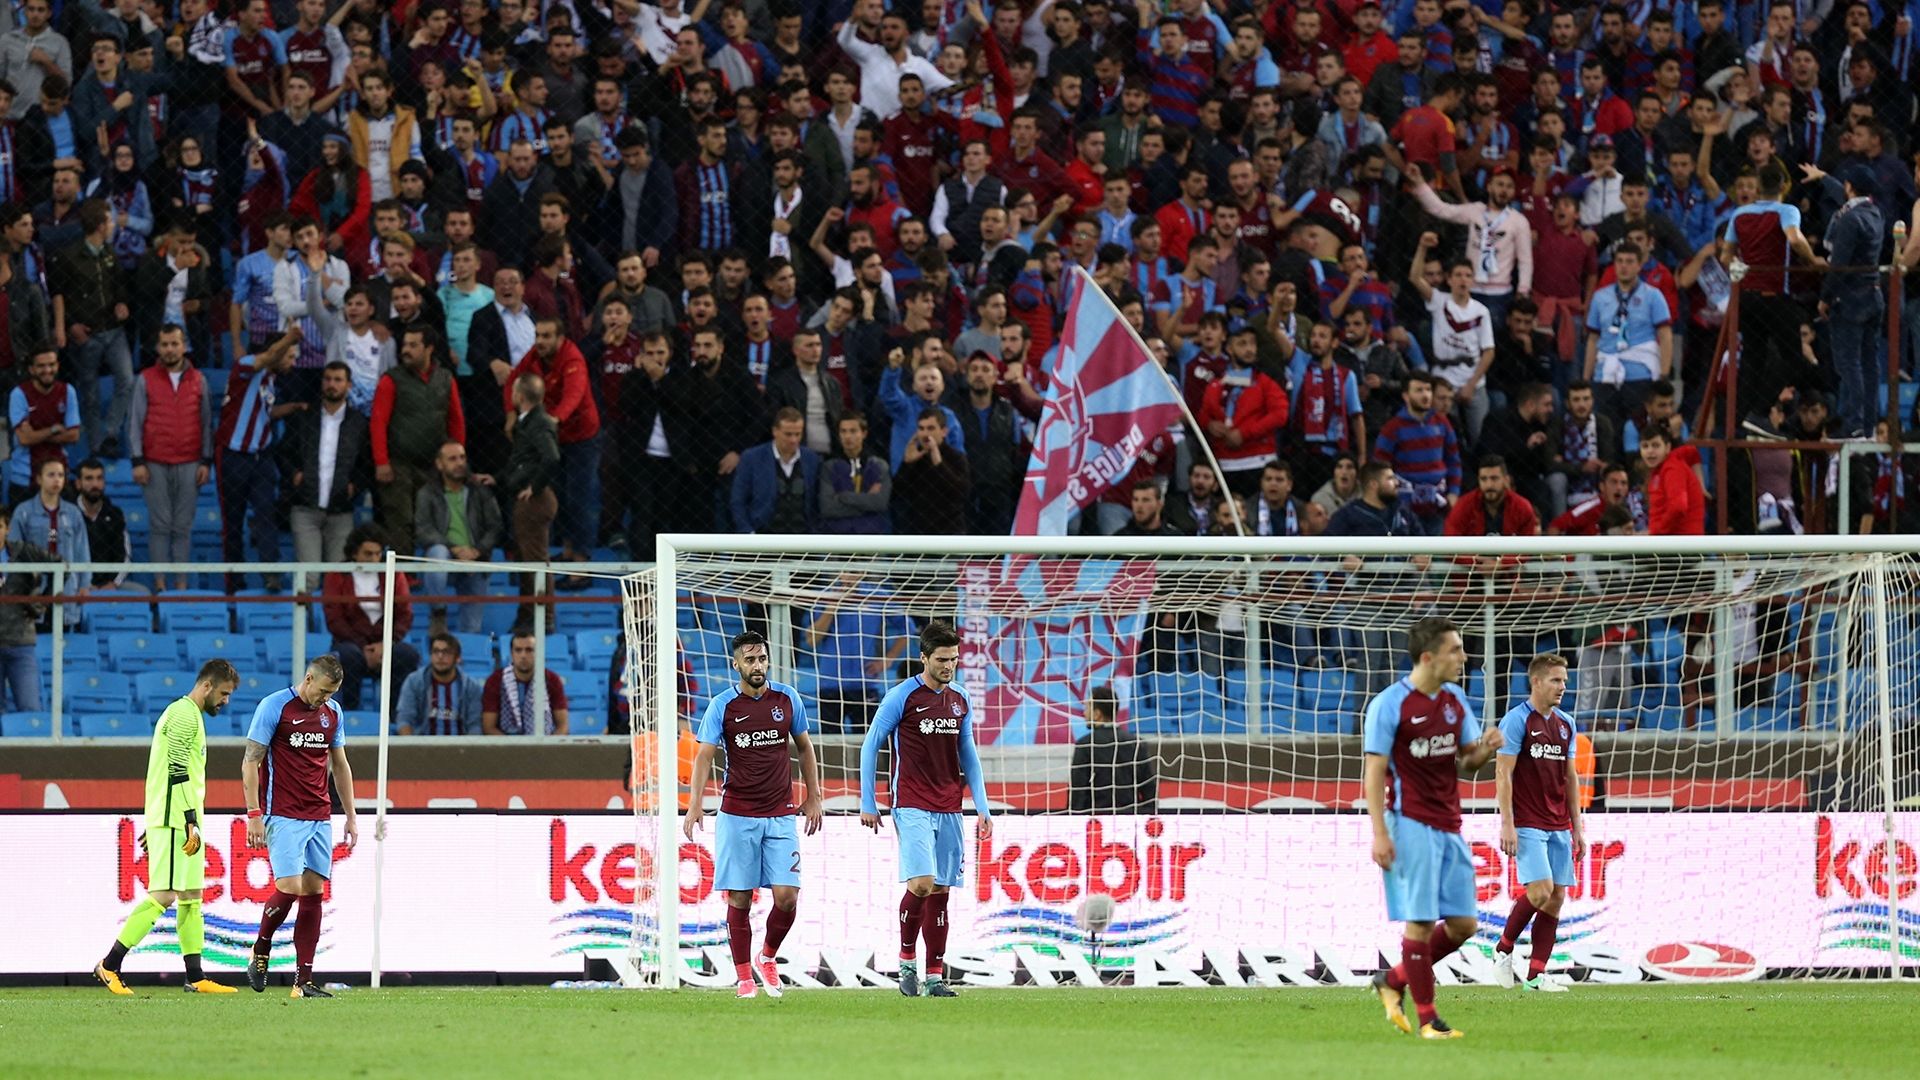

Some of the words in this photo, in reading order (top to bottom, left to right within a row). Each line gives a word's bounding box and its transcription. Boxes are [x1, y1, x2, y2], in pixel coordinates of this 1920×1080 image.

[935, 718, 957, 728] QNB
[304, 732, 325, 742] QNB
[752, 730, 778, 741] QNB
[976, 817, 1206, 903] kebir
